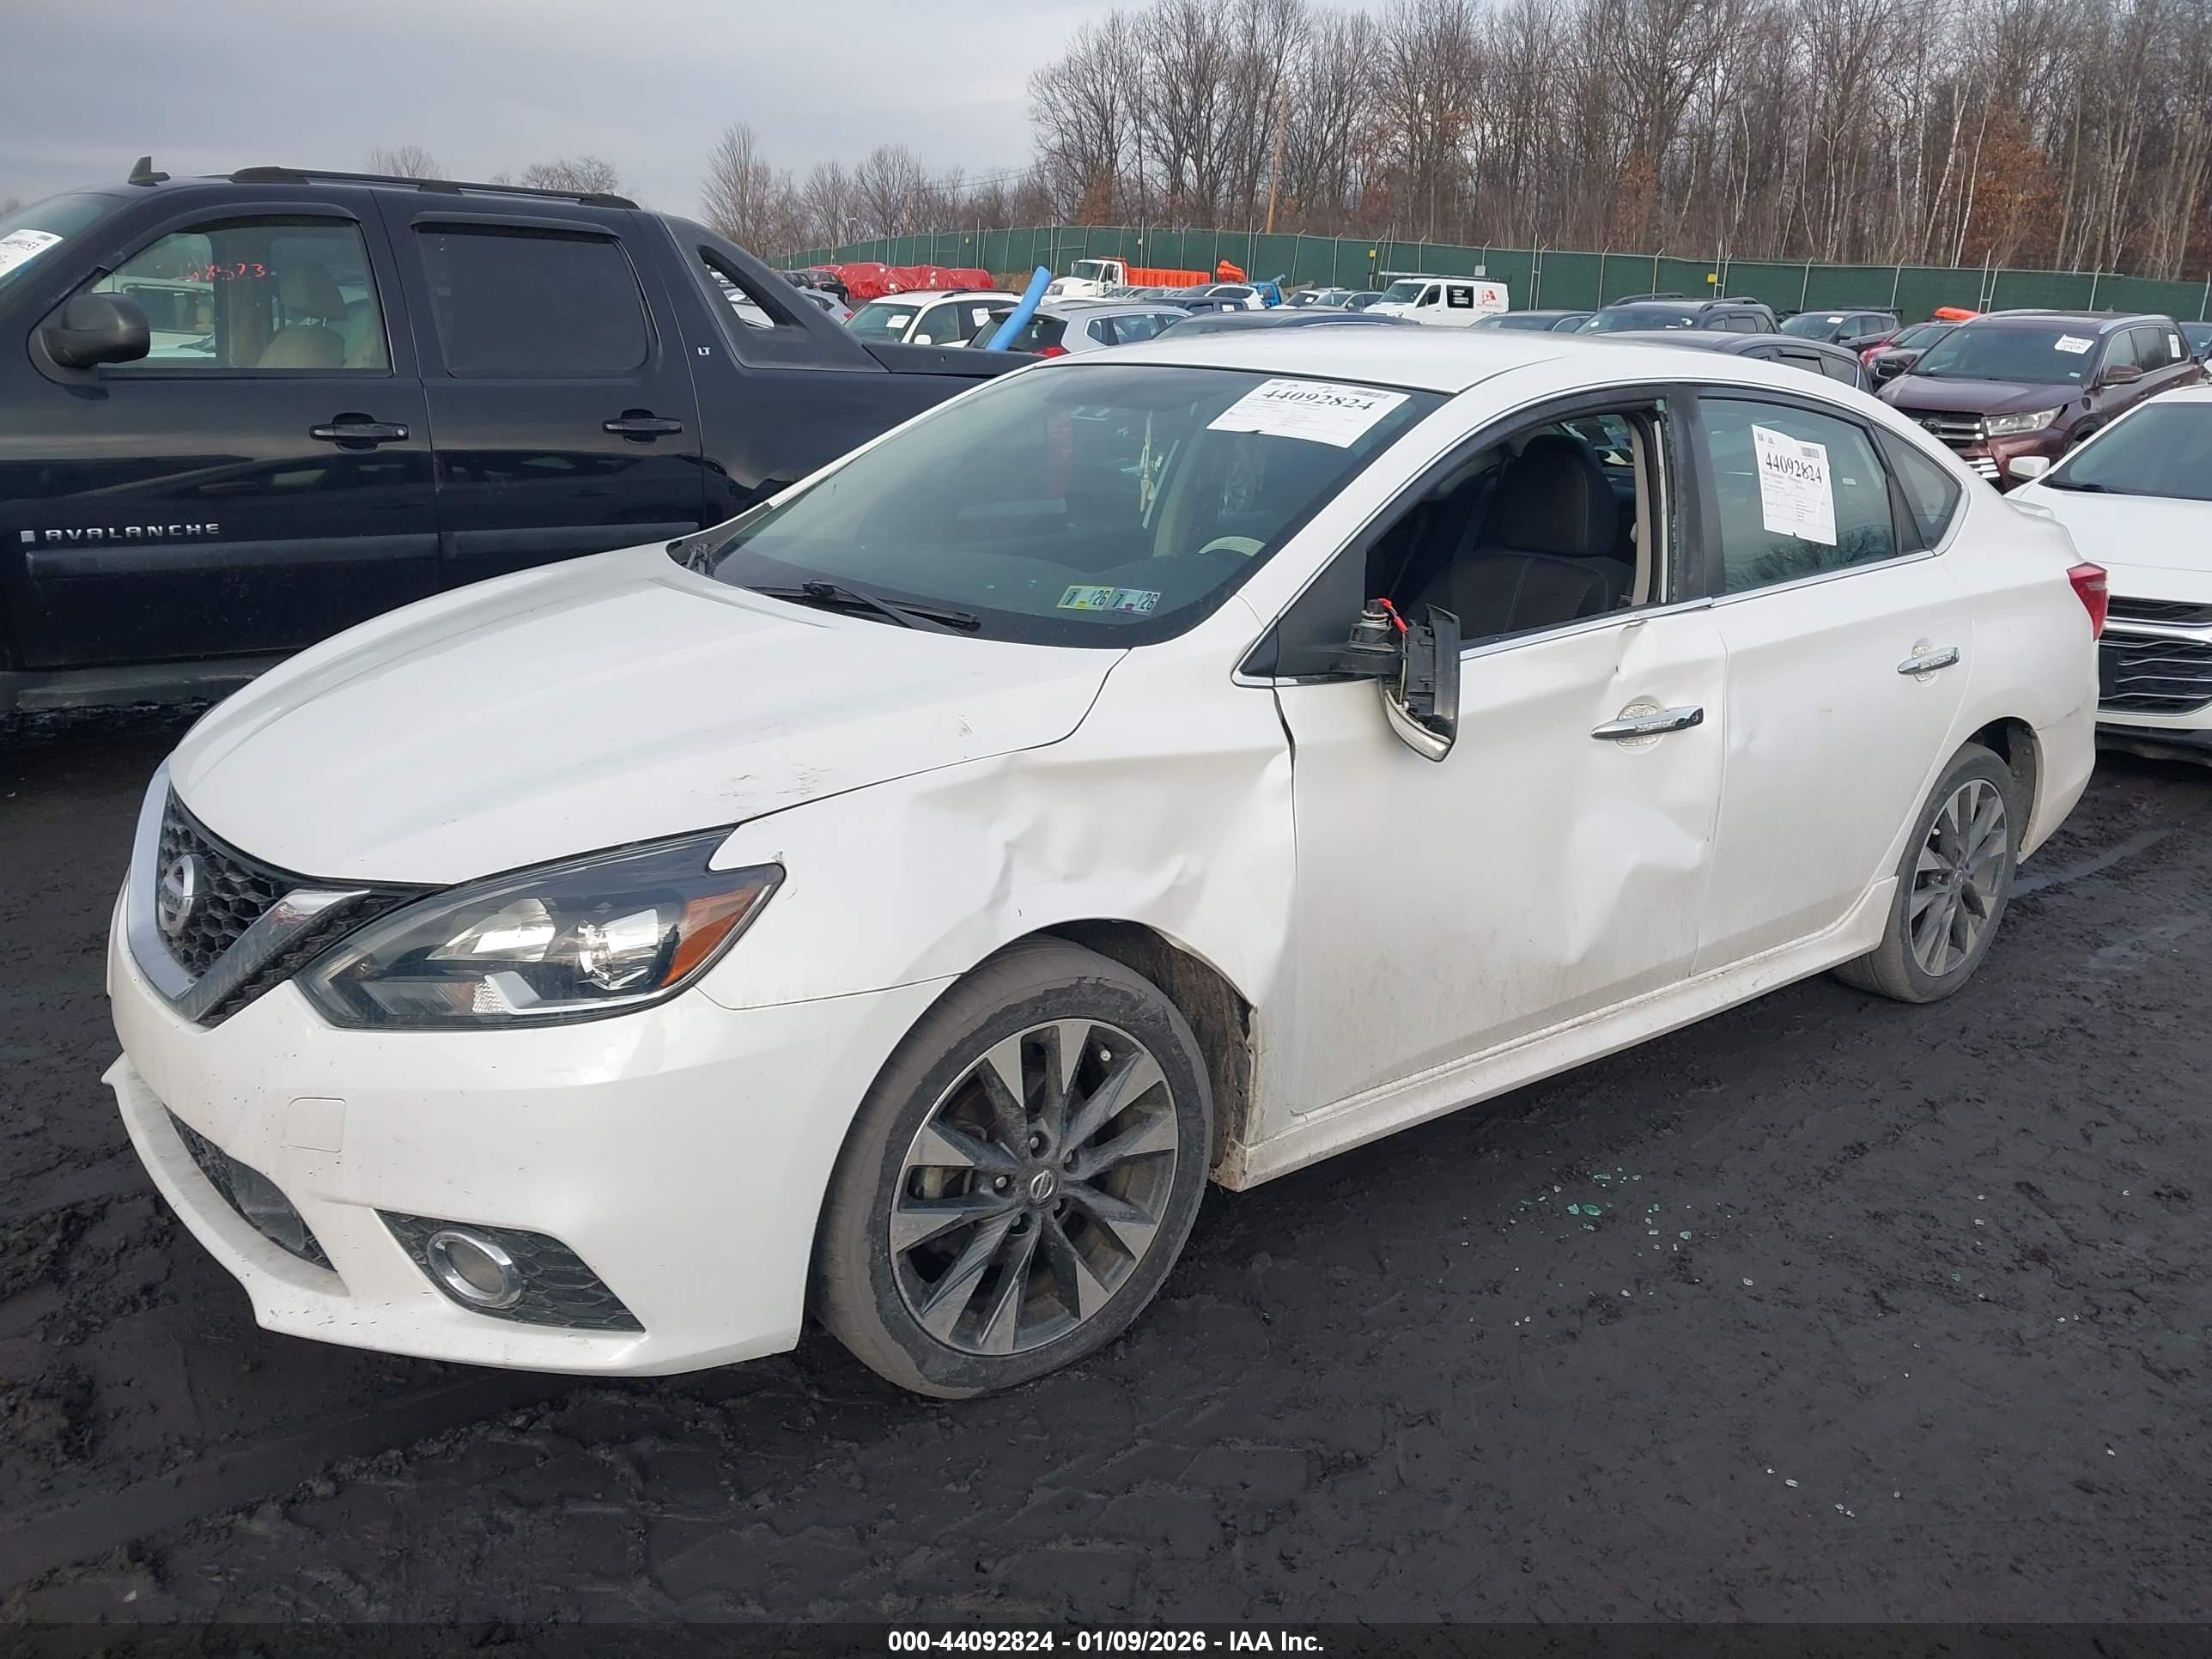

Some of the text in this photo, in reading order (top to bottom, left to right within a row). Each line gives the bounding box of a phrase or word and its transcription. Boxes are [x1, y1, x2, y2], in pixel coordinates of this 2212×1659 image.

[697, 346, 711, 356] LT
[1261, 388, 1376, 411] 44092824
[1765, 452, 1823, 484] 44092824
[45, 522, 221, 541] AVALANCHE
